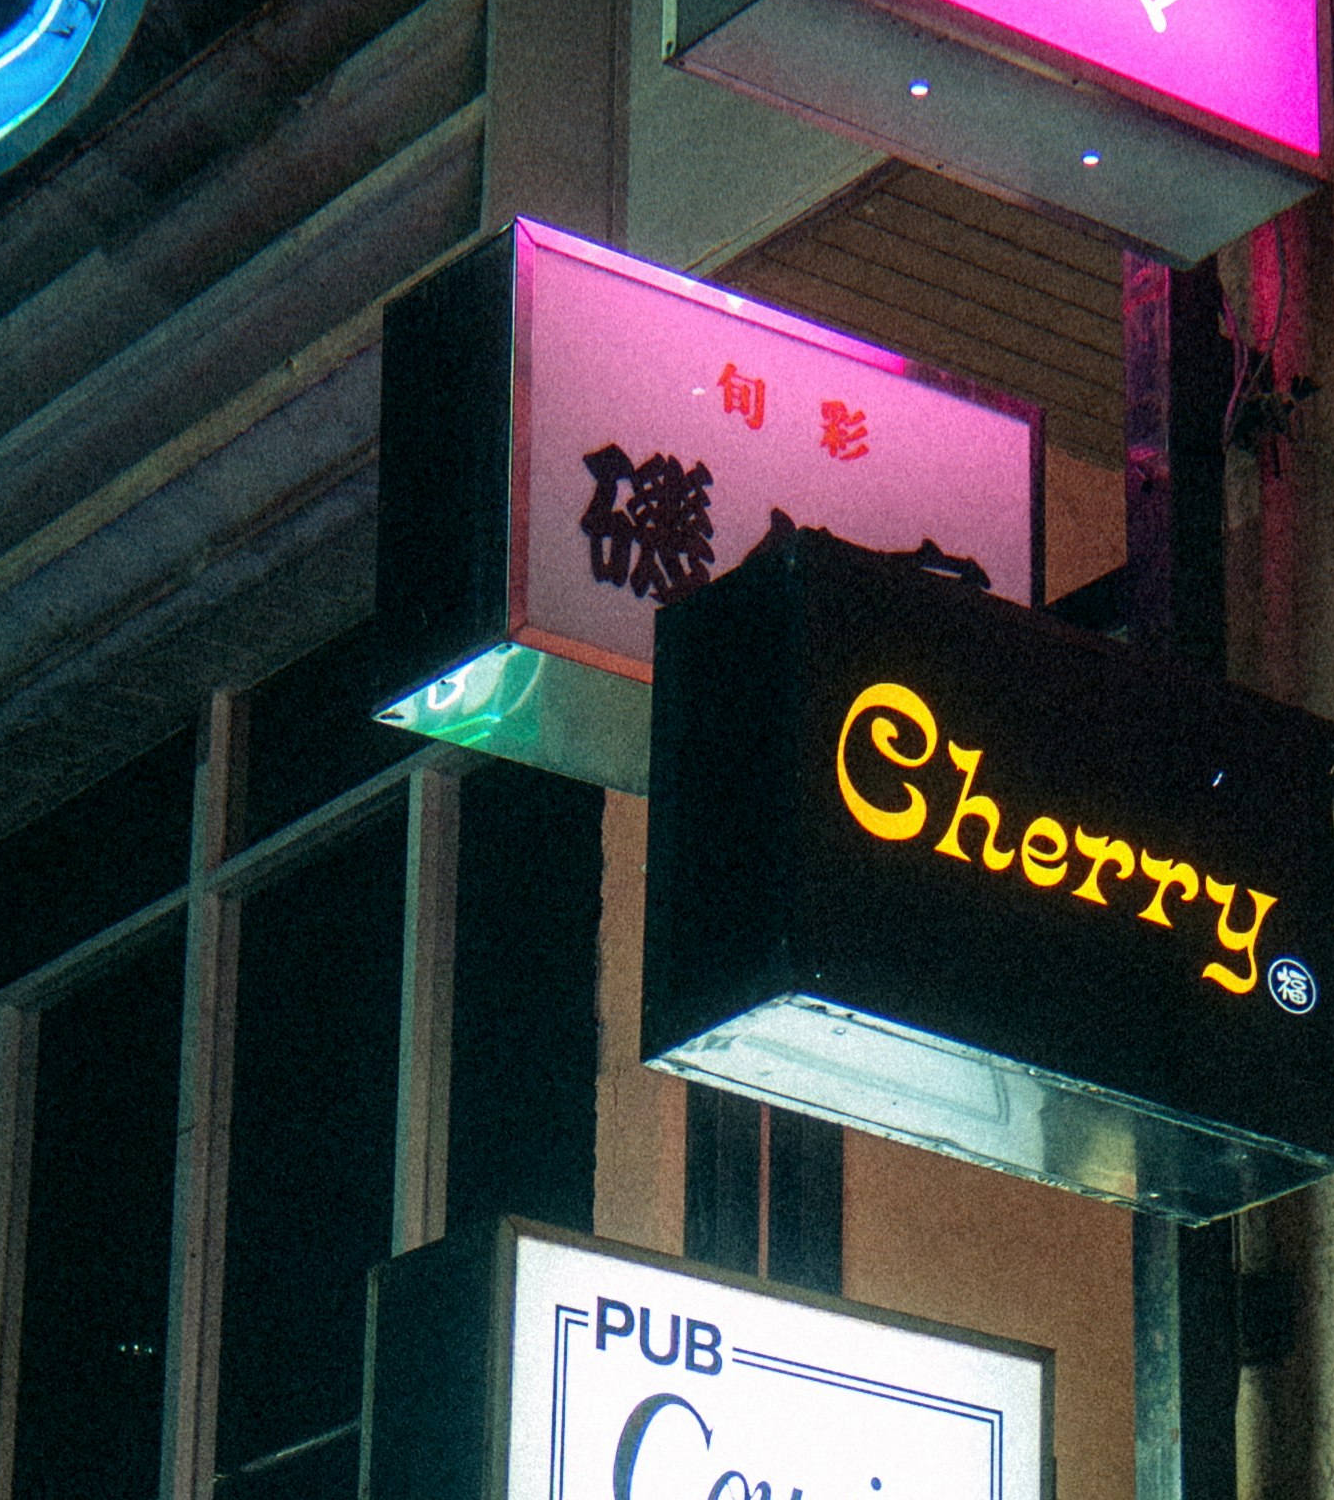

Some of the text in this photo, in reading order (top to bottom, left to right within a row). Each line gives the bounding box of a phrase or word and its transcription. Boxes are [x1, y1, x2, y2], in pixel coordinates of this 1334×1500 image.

[717, 363, 869, 460] 旬彩
[836, 682, 1278, 994] Cherry
[596, 1296, 724, 1376] PUB
